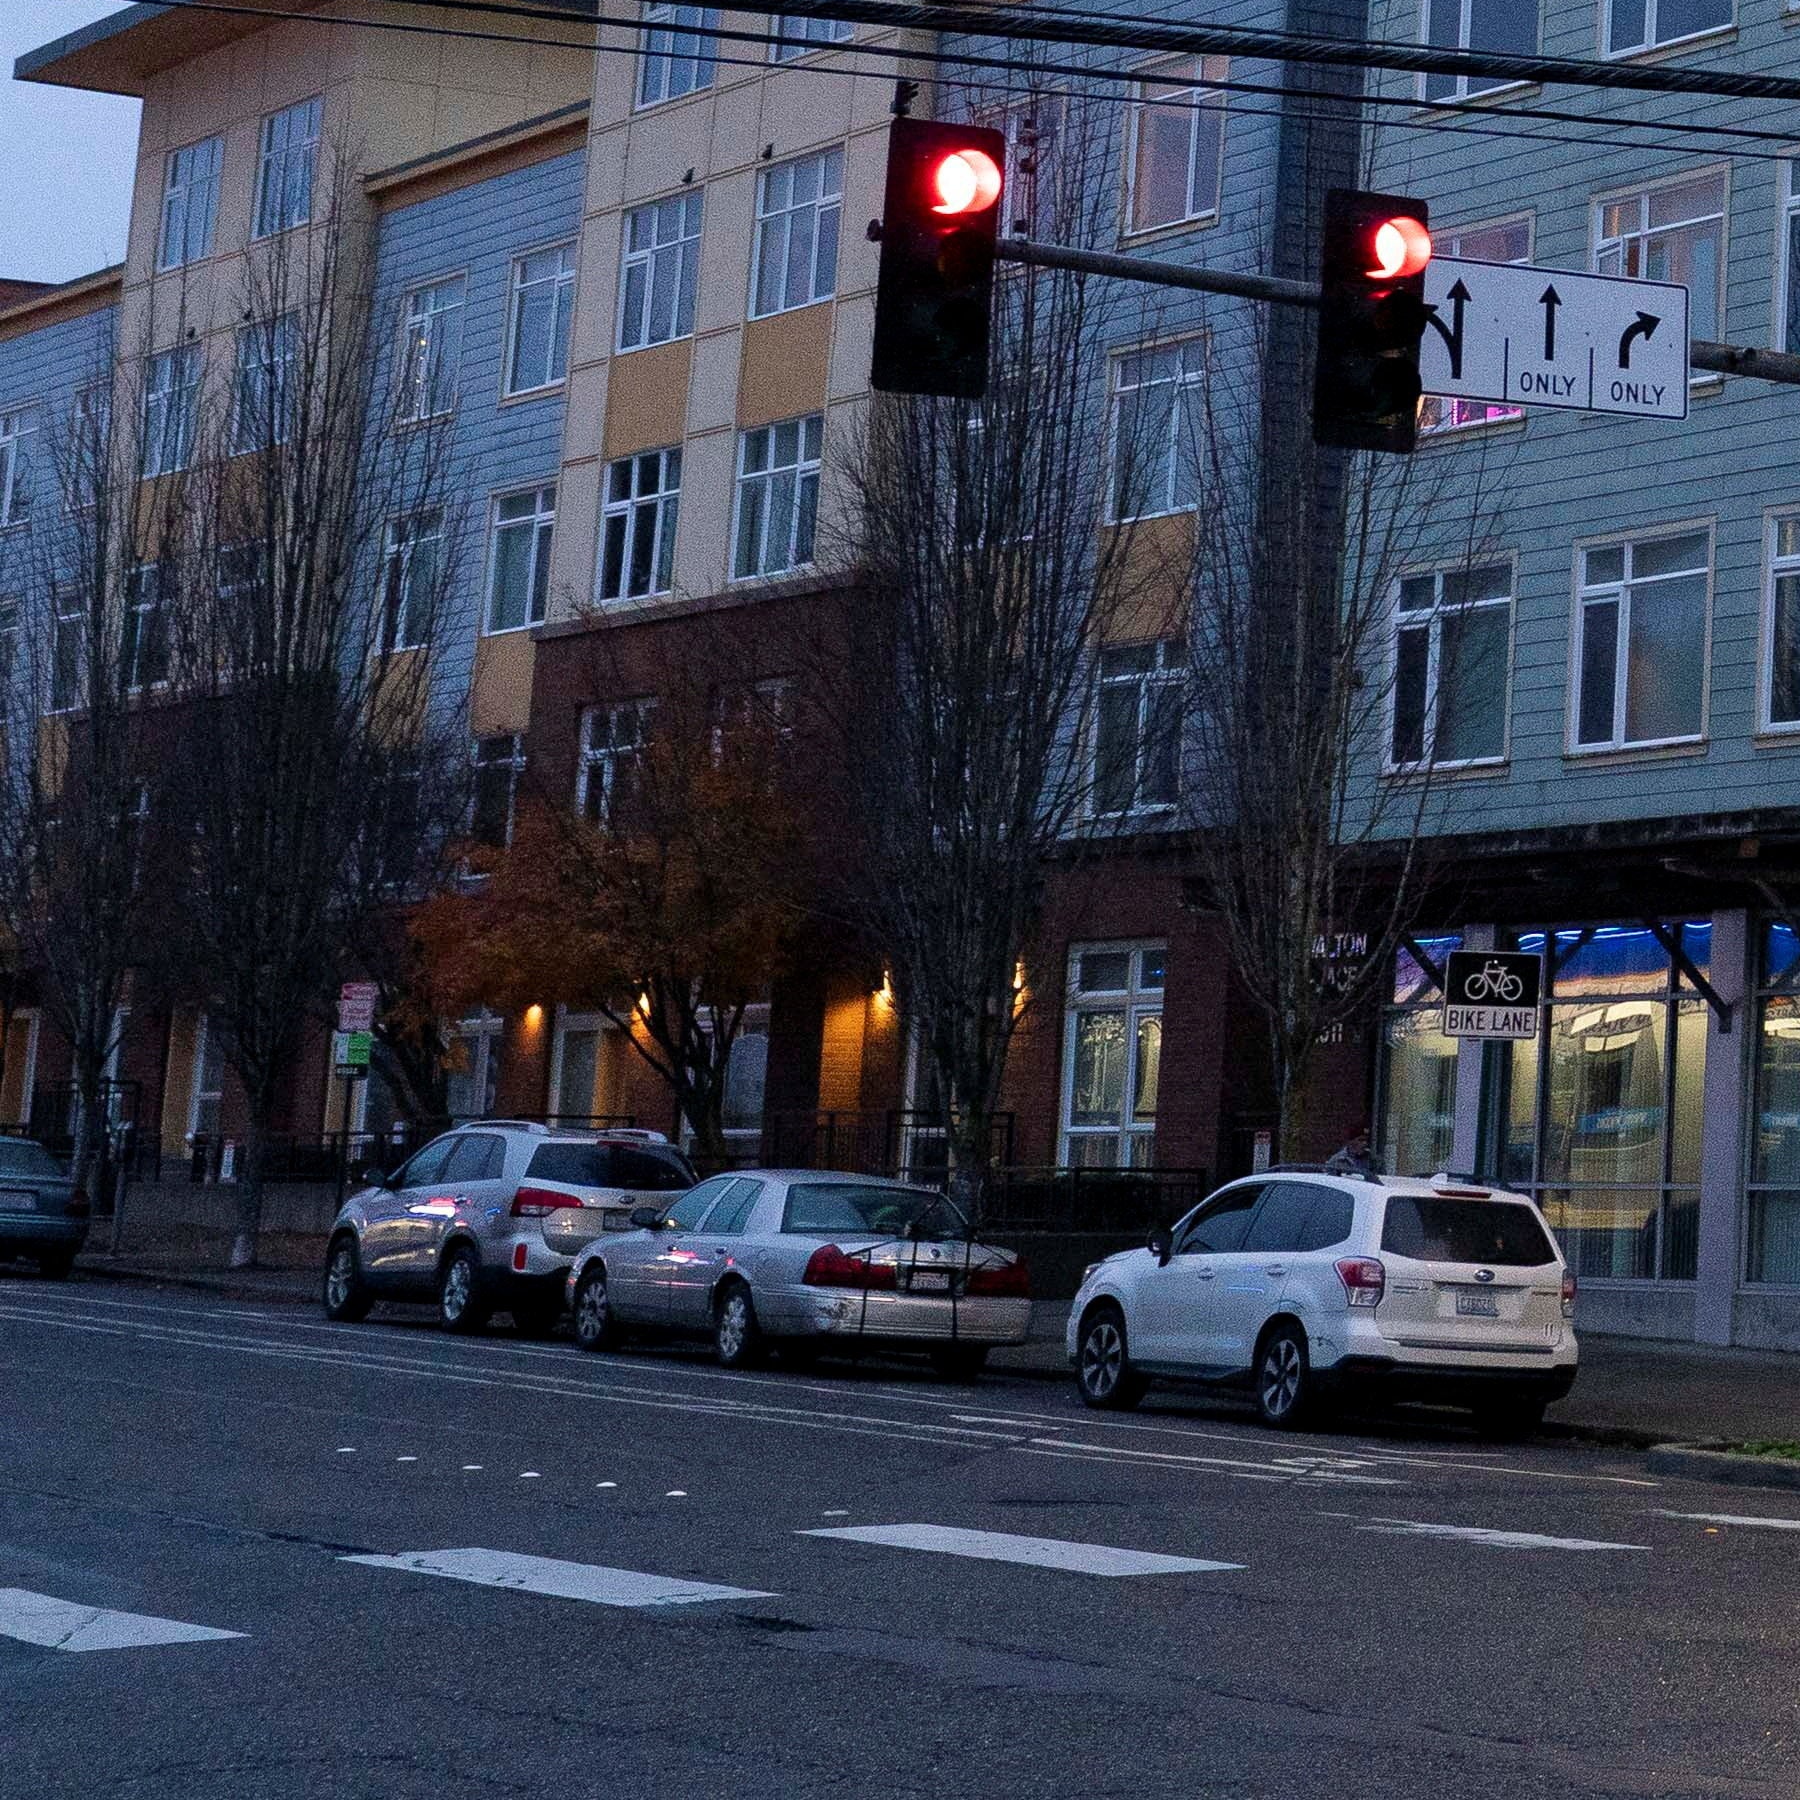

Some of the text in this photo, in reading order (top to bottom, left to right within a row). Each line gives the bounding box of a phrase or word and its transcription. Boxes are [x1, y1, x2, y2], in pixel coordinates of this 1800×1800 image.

[1519, 371, 1576, 396] ONLY
[1610, 381, 1666, 406] ONLY
[1448, 1010, 1533, 1032] BIKE LANE
